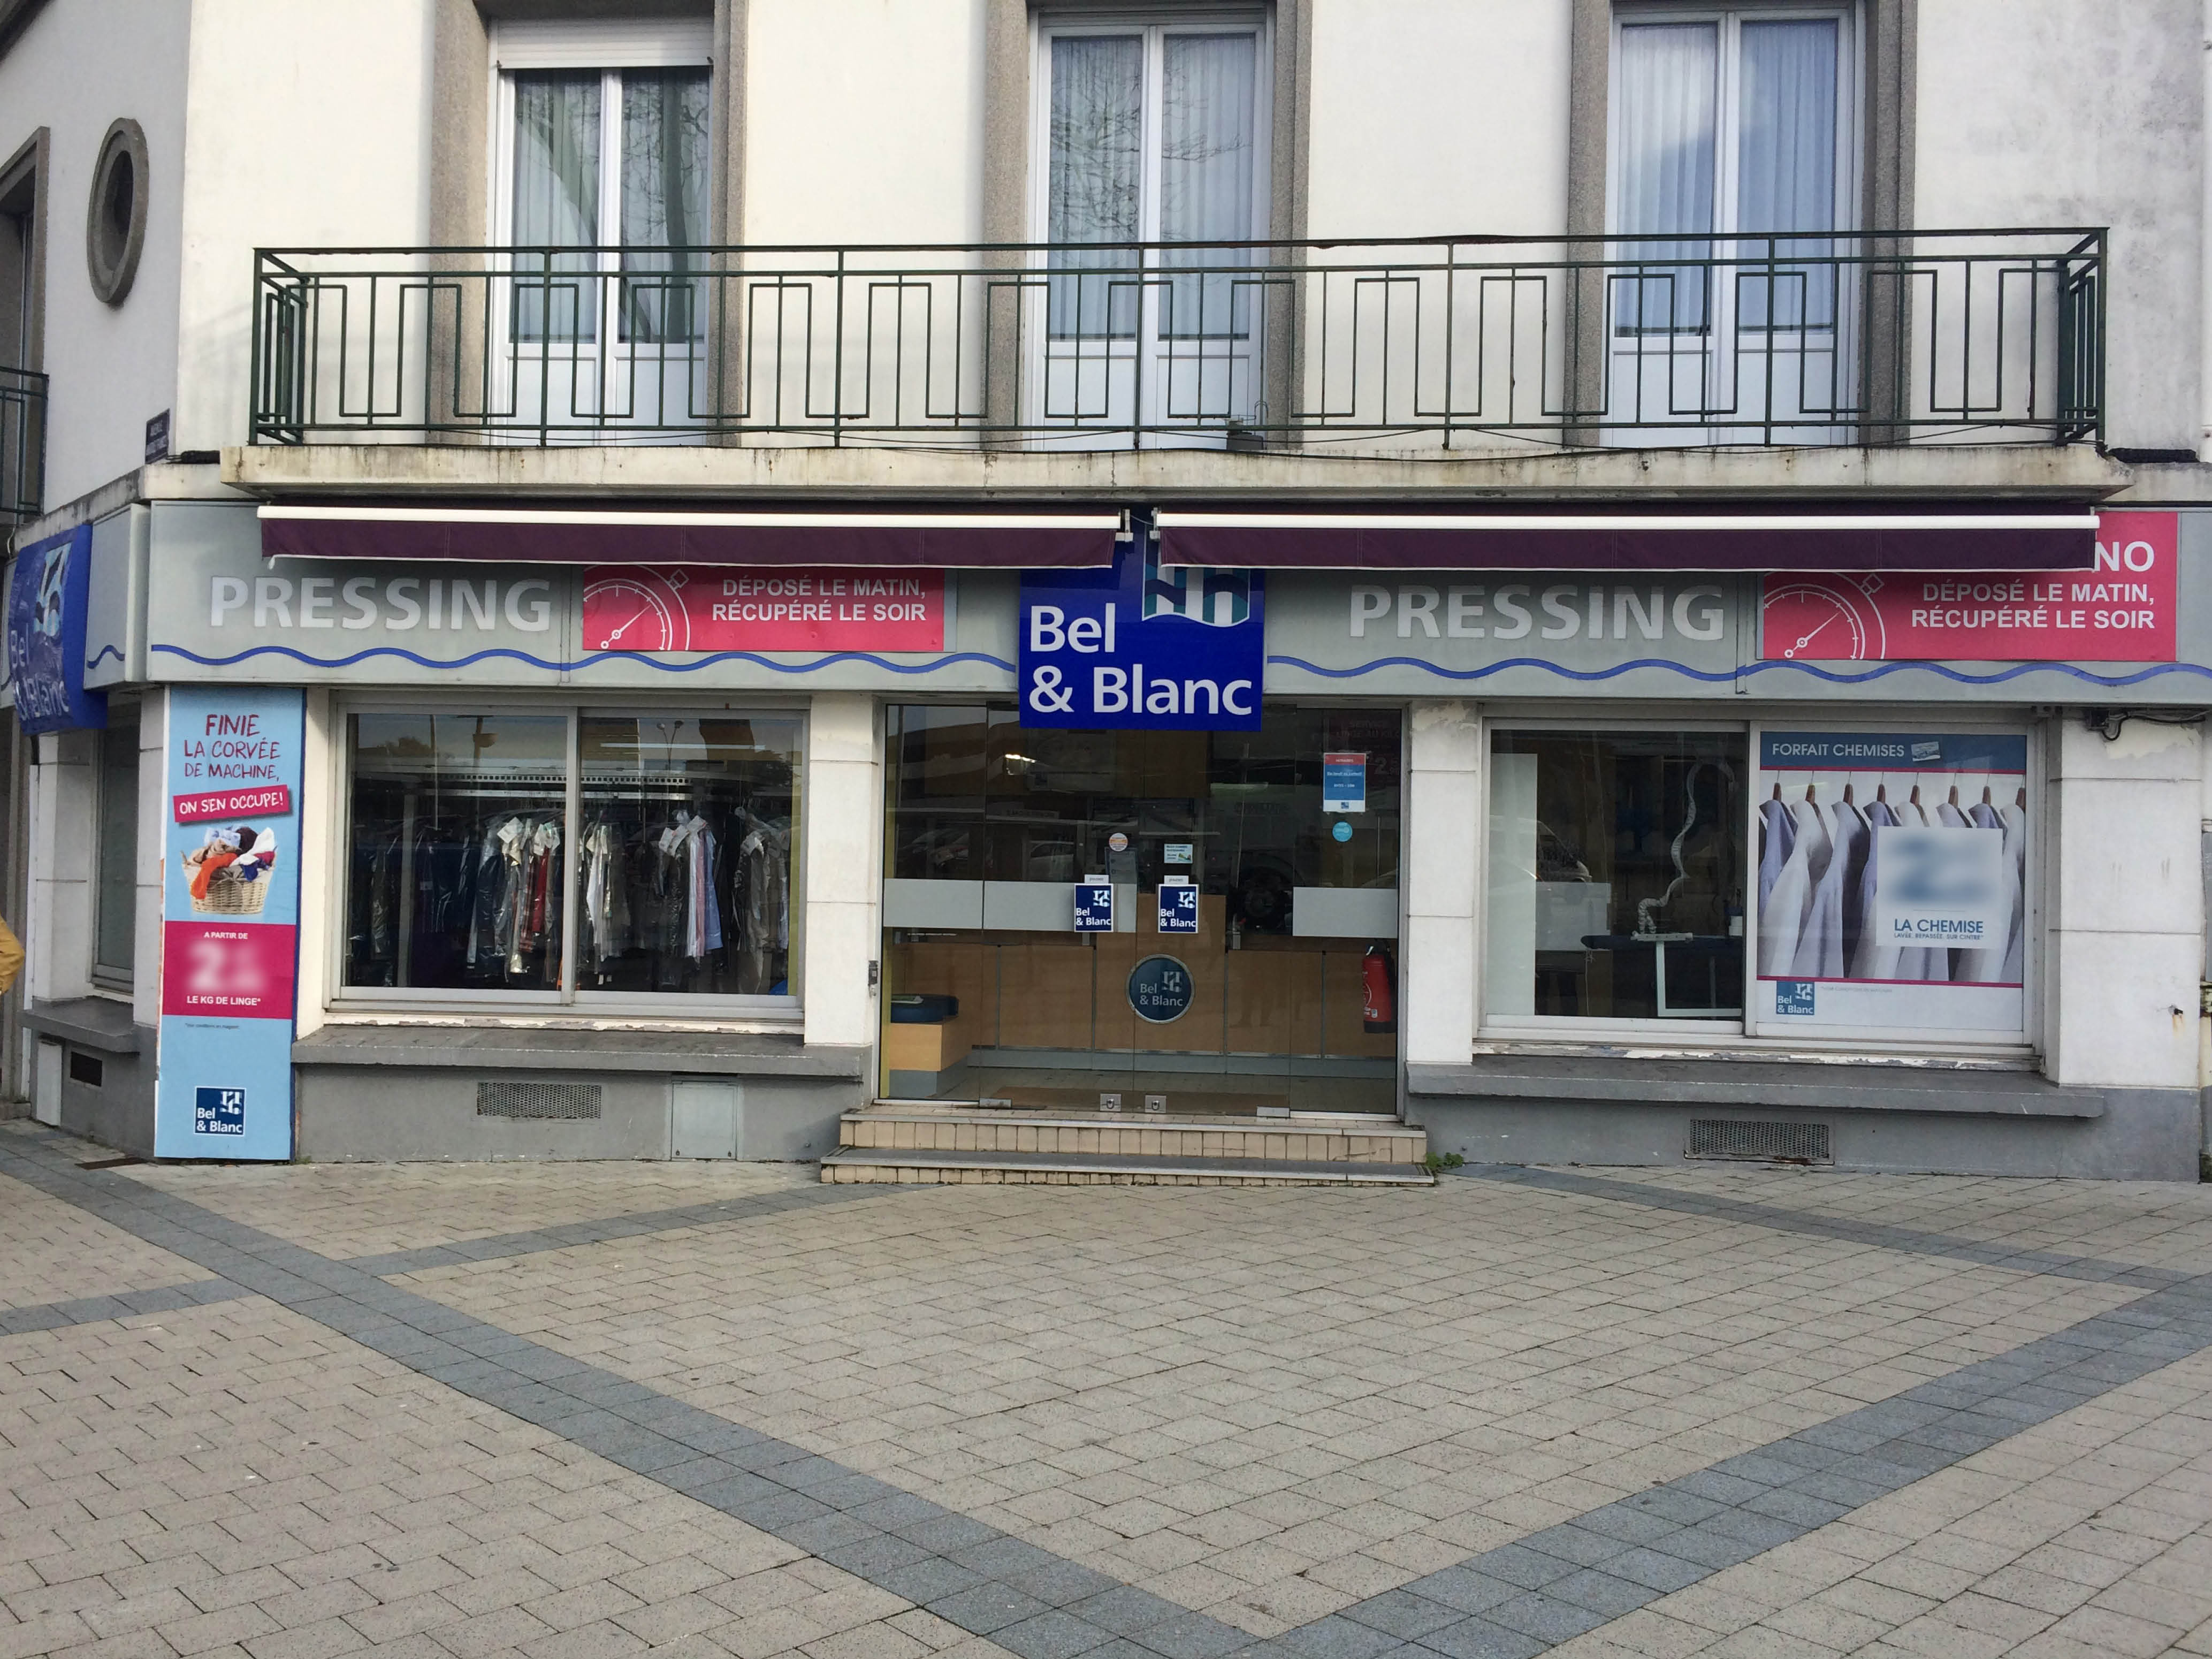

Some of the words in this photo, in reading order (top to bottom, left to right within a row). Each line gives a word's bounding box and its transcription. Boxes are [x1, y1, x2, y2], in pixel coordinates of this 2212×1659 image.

[2094, 541, 2155, 572] NO
[722, 574, 812, 597] DÉPOSÉ
[819, 579, 846, 597] LE
[853, 579, 926, 599] MATIN,
[1923, 579, 2024, 603] DÉPOSÉ
[2033, 583, 2063, 603] LE
[2071, 583, 2154, 605] MATIN,
[209, 575, 551, 631] PRESSING
[712, 599, 832, 621] RÉCUPÉRÉ
[839, 604, 866, 621] LE
[873, 603, 926, 621] SOIR
[1349, 584, 1725, 641] PRESSING
[1911, 605, 2048, 629] RÉCUPÉRÉ
[2056, 610, 2086, 628] LE
[2093, 610, 2155, 629] SOIR
[1030, 603, 1116, 653] Bel
[11, 622, 29, 668] Bel
[1028, 665, 1075, 713] &
[1093, 664, 1253, 716] Blanc
[205, 713, 261, 737] FINIE
[184, 739, 205, 758] LA
[211, 737, 281, 759] CORVÉE
[1772, 743, 1829, 757] FORFAIT
[1833, 744, 1905, 758] CHEMISES
[184, 763, 203, 777] DE
[208, 763, 280, 781] MACHINE,
[179, 801, 197, 814] ON
[230, 792, 284, 809] OCCUPE!
[1076, 907, 1090, 916] Bel
[1160, 908, 1174, 917] Bel
[1076, 917, 1084, 926] &
[1086, 917, 1111, 926] Blanc
[1160, 918, 1168, 927] &
[1170, 918, 1196, 927] Blanc
[1894, 918, 1913, 932] LA
[1917, 919, 1984, 933] CHEMISE
[1139, 983, 1157, 994] Bel
[187, 995, 199, 1004] LE
[200, 996, 214, 1004] KG
[216, 996, 228, 1004] DE
[1139, 995, 1149, 1006] &
[1151, 994, 1184, 1007] Blanc
[1778, 995, 1792, 1004] Bel
[1777, 1004, 1785, 1013] &
[1787, 1004, 1813, 1014] Blanc
[196, 1107, 216, 1120] Bel
[196, 1120, 207, 1132] &
[209, 1120, 243, 1133] Blanc
